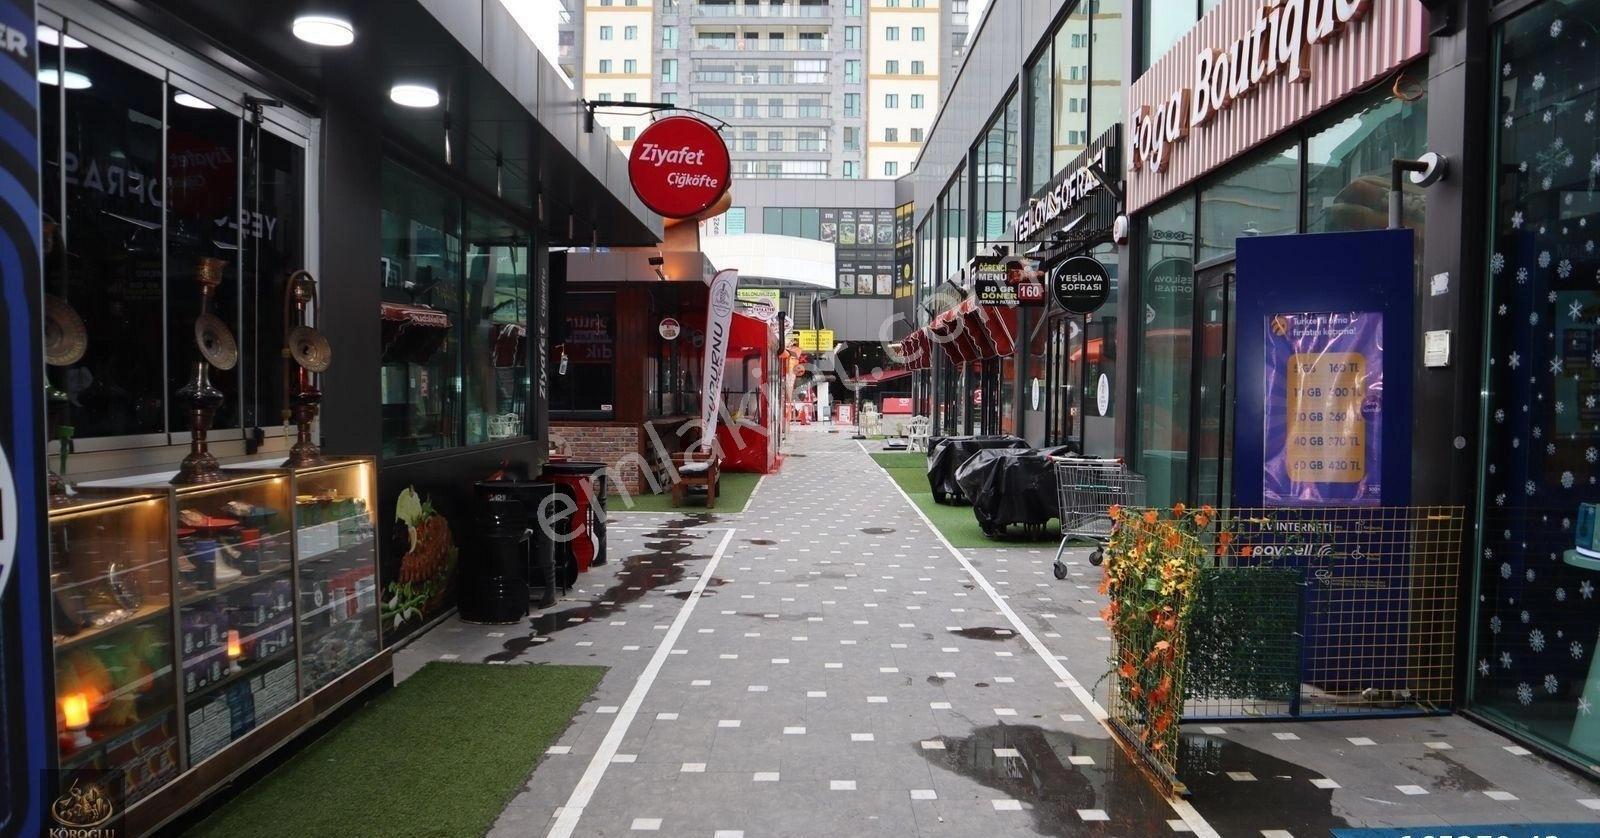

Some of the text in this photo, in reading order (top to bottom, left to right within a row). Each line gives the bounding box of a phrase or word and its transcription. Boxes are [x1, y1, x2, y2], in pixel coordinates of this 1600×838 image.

[1128, 88, 1184, 173] Foga
[639, 143, 705, 166] Ziyafet
[667, 172, 718, 188] Çiğköfte
[1059, 272, 1103, 283] YEŞİLOVA
[1020, 285, 1039, 298] 160
[1061, 283, 1102, 291] SOFRASI
[539, 324, 548, 400] Ziyafet
[1293, 388, 1304, 397] 1
[1307, 388, 1322, 397] GB
[1310, 412, 1323, 421] GB
[1310, 436, 1323, 446] GB
[1350, 436, 1361, 446] TL
[1310, 461, 1323, 470] GB
[1329, 461, 1347, 470] 420
[1350, 461, 1361, 470] TL
